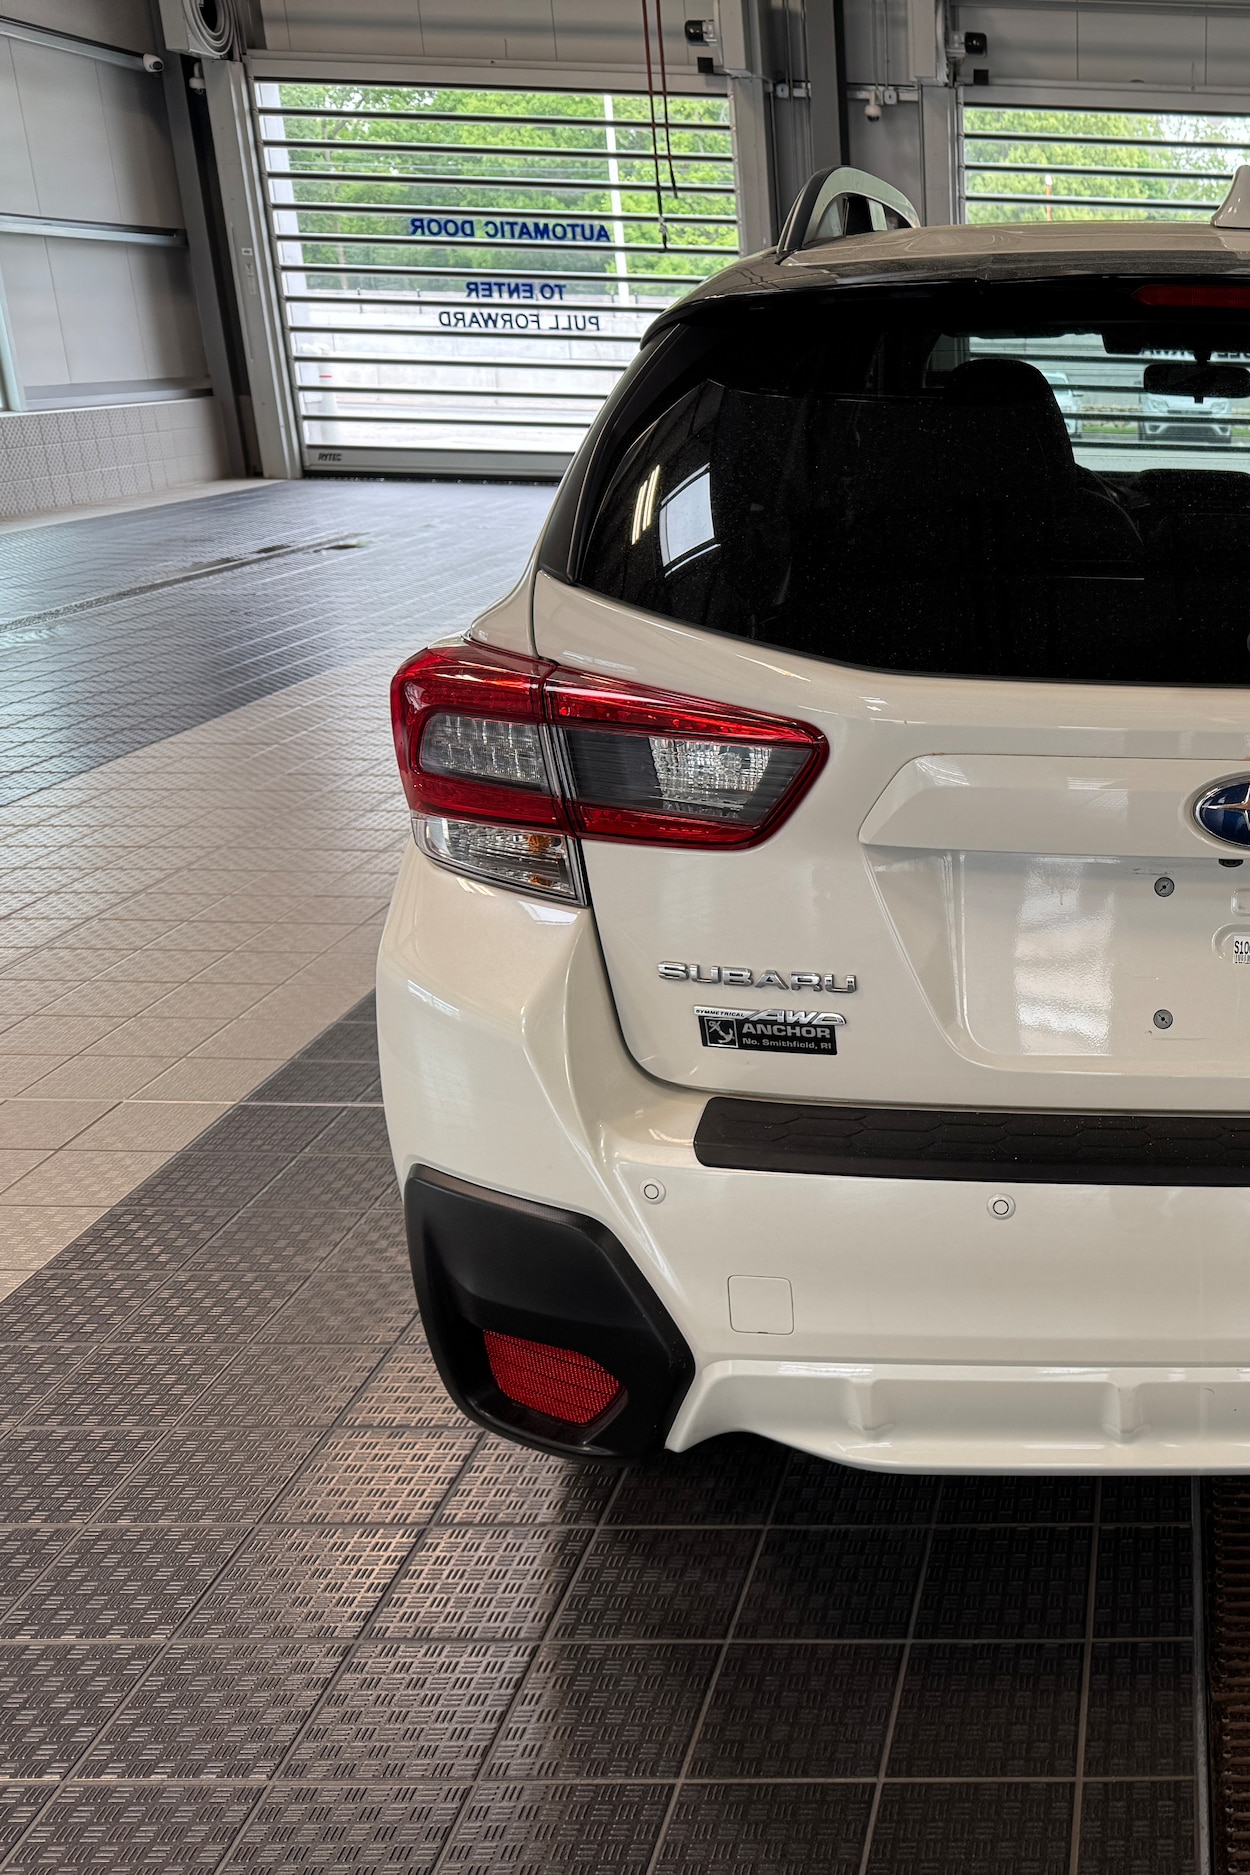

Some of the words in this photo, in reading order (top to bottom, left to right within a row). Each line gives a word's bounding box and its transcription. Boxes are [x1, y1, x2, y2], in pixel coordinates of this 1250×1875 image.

[657, 960, 857, 993] SUBARU
[695, 1008, 745, 1018] SYMMETRICAL
[748, 1008, 847, 1026] AWD
[741, 1023, 831, 1039] ANCHOR
[742, 1037, 760, 1046] No.
[762, 1038, 818, 1050] Smithfield,
